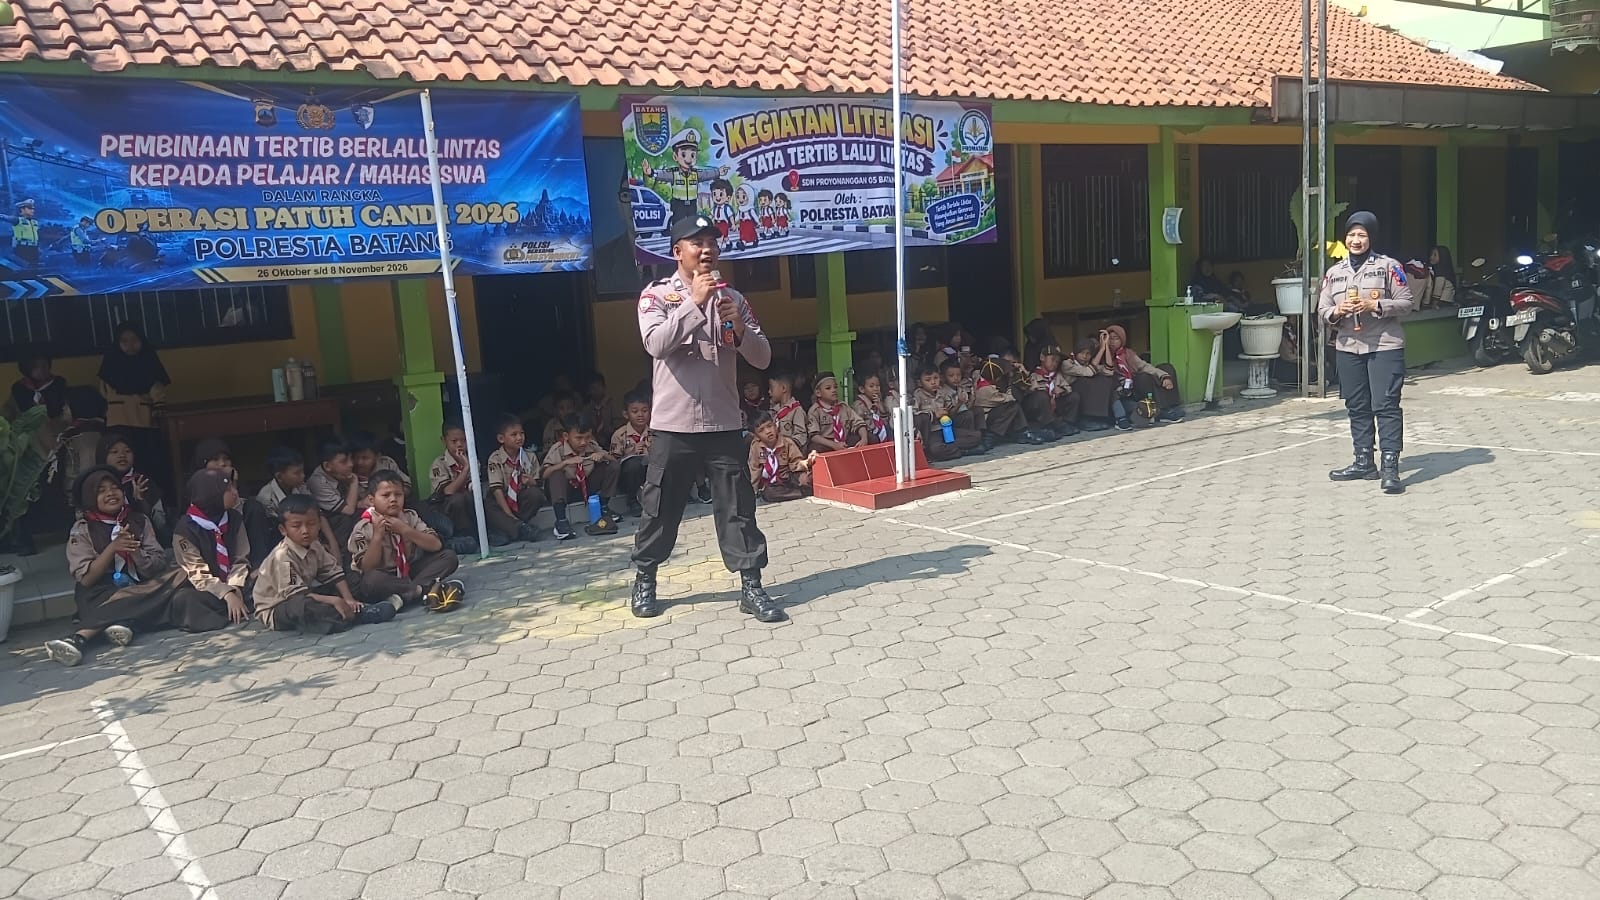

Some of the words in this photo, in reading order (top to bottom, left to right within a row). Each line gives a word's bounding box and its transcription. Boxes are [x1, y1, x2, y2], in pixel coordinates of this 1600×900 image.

[725, 106, 836, 153] KEGIATAN
[101, 135, 249, 157] PEMBINAAN
[255, 136, 334, 157] TERTIB
[748, 150, 785, 176] TATA
[787, 143, 838, 166] TERTIB
[842, 143, 875, 162] LALU
[130, 164, 231, 187] KEPADA
[237, 164, 340, 186] PELAJAR
[344, 163, 355, 185] /
[802, 178, 815, 187] SDN
[816, 176, 868, 186] PROYONANGGAN
[868, 176, 877, 184] 05
[263, 190, 316, 202] DALAM
[320, 190, 383, 202] RANGKA
[834, 193, 857, 205] Oleh
[96, 207, 249, 233] OPERASI
[254, 206, 355, 229] PATUH
[456, 203, 519, 225] 2026
[634, 209, 661, 220] POLISI
[800, 206, 859, 222] POLRESTA
[195, 235, 344, 260] POLRESTA
[521, 241, 551, 249] POLISI
[258, 269, 269, 278] 26
[272, 267, 311, 277] Oktober
[314, 266, 328, 275] s/d
[331, 266, 336, 275] 8
[339, 264, 385, 275] November
[387, 263, 408, 272] 2026
